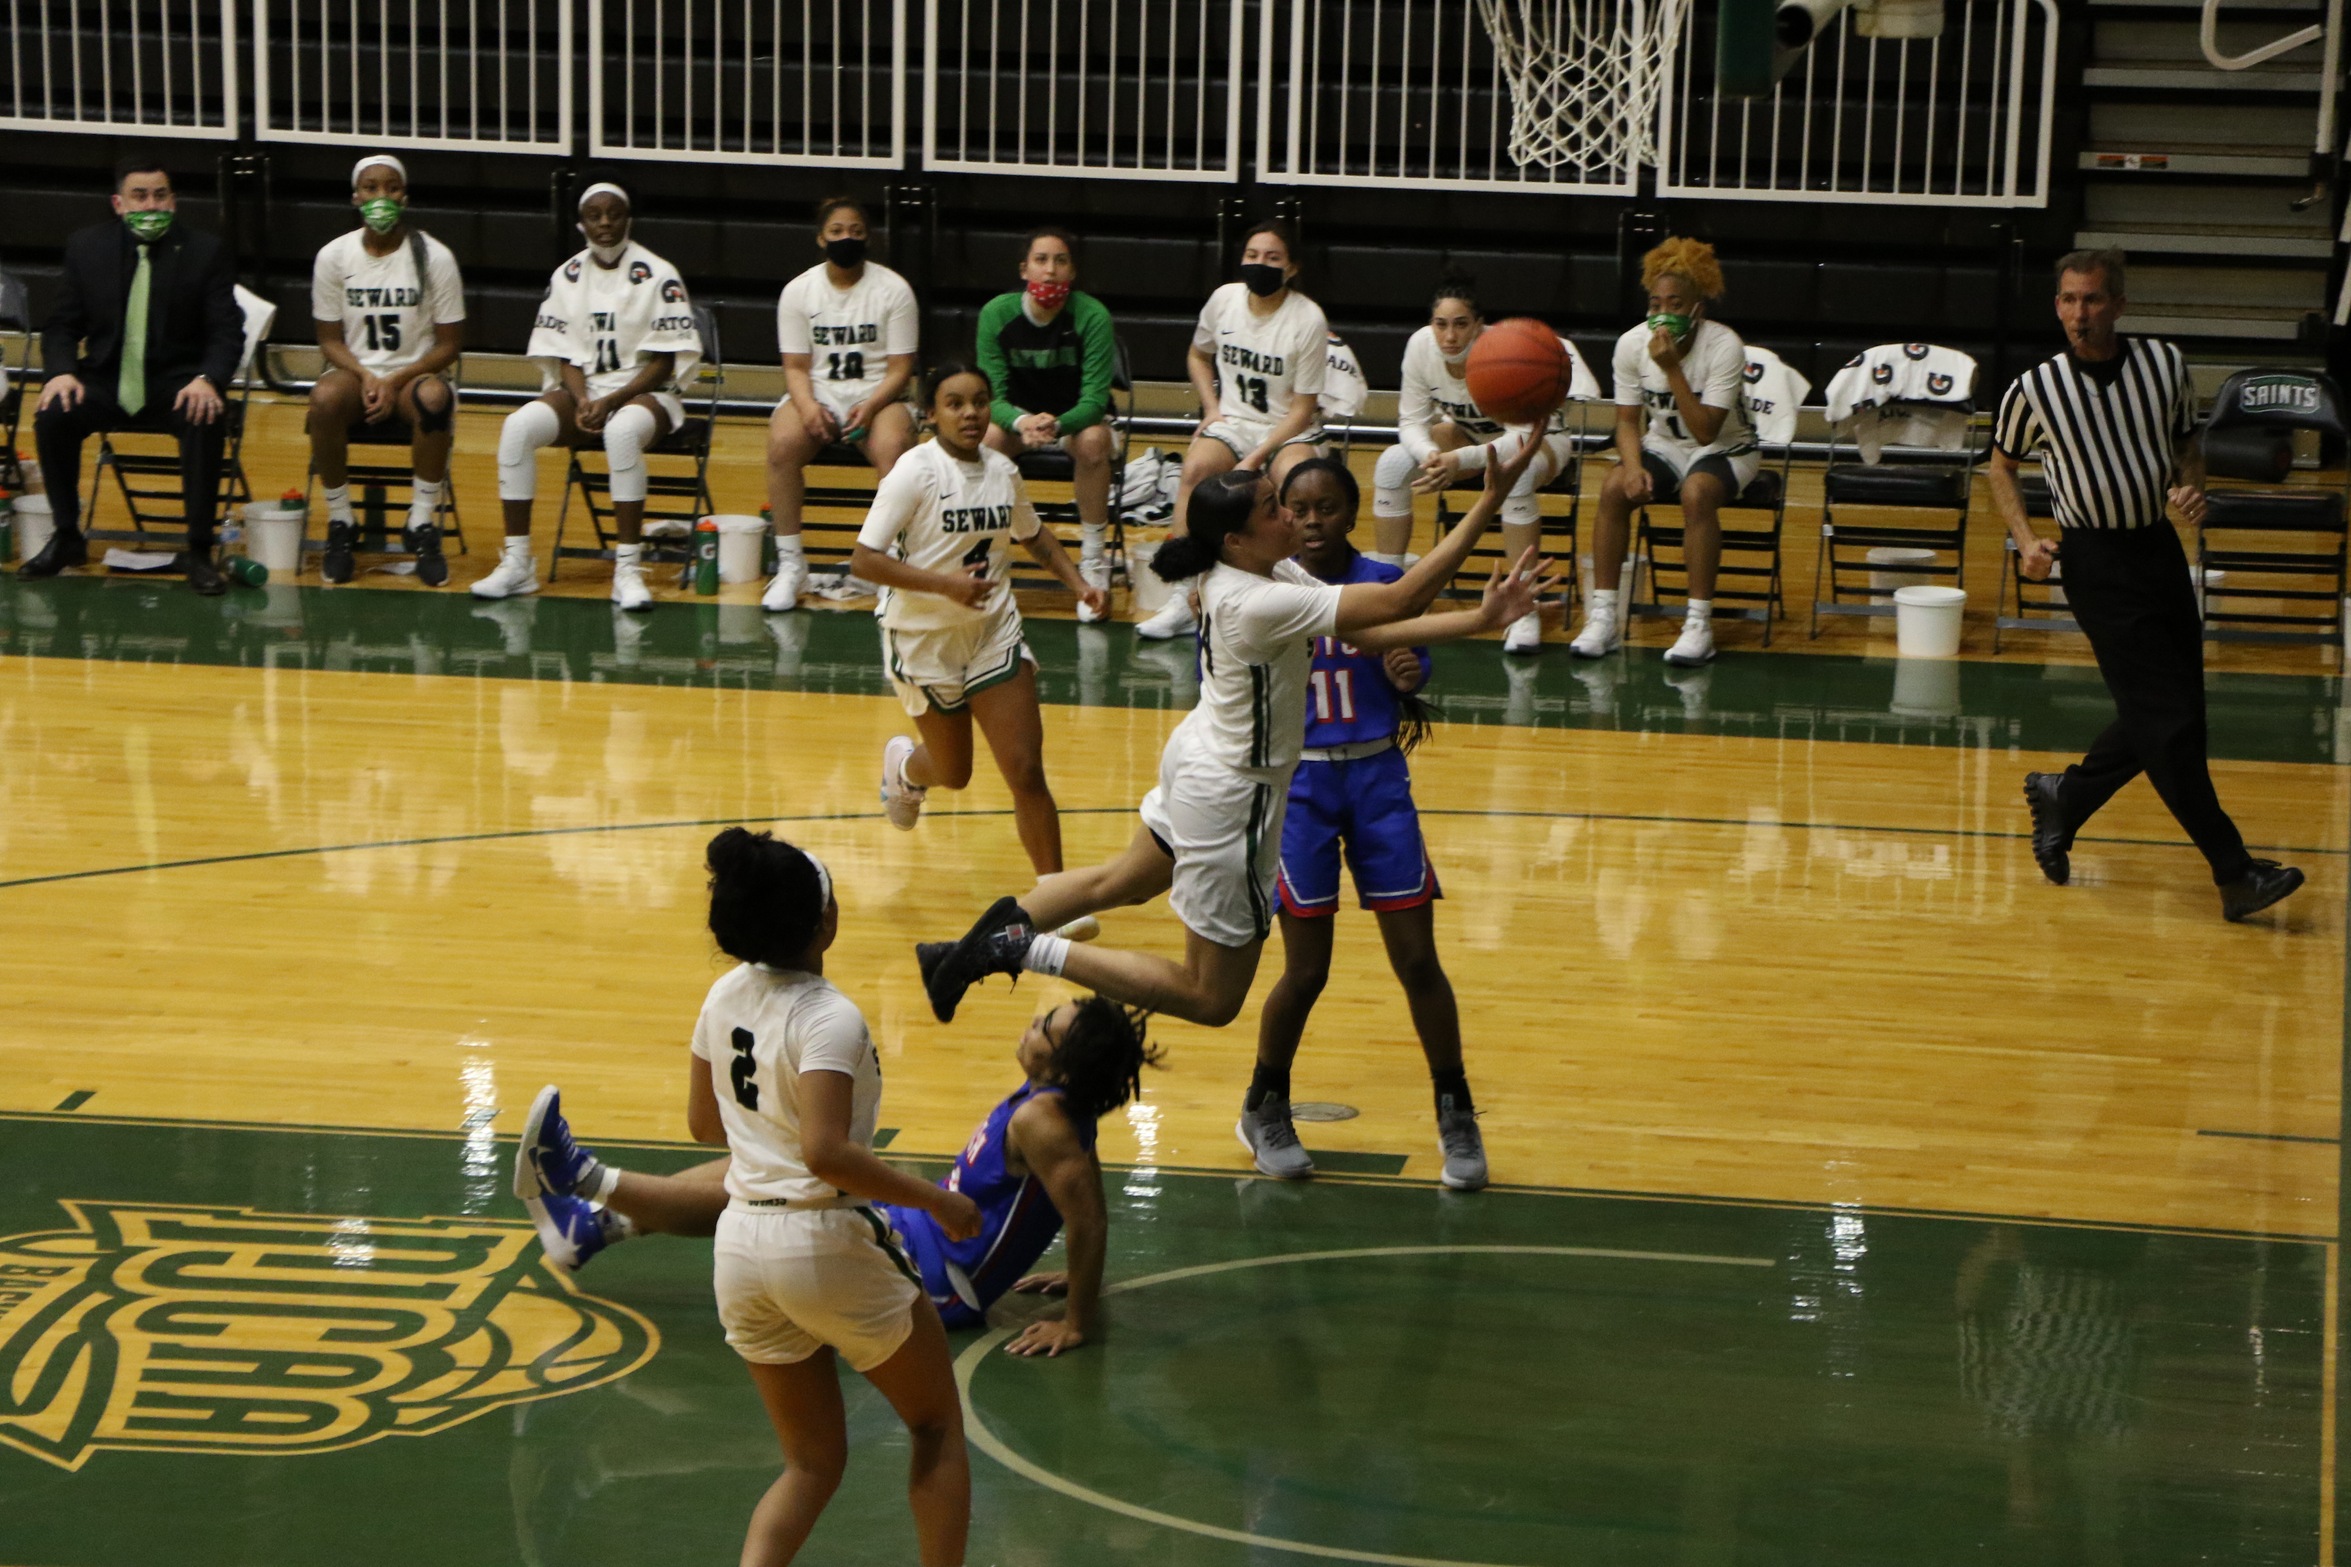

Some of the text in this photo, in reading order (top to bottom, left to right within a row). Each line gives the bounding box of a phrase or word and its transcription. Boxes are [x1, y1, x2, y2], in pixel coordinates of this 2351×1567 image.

[346, 288, 421, 307] SEWARD
[364, 314, 401, 351] 15
[1222, 344, 1284, 377] SEWARD
[1235, 374, 1269, 414] 13
[2243, 384, 2317, 407] SAINTS
[963, 538, 990, 580] 4
[1310, 669, 1356, 723] 11
[730, 1026, 759, 1112] 2
